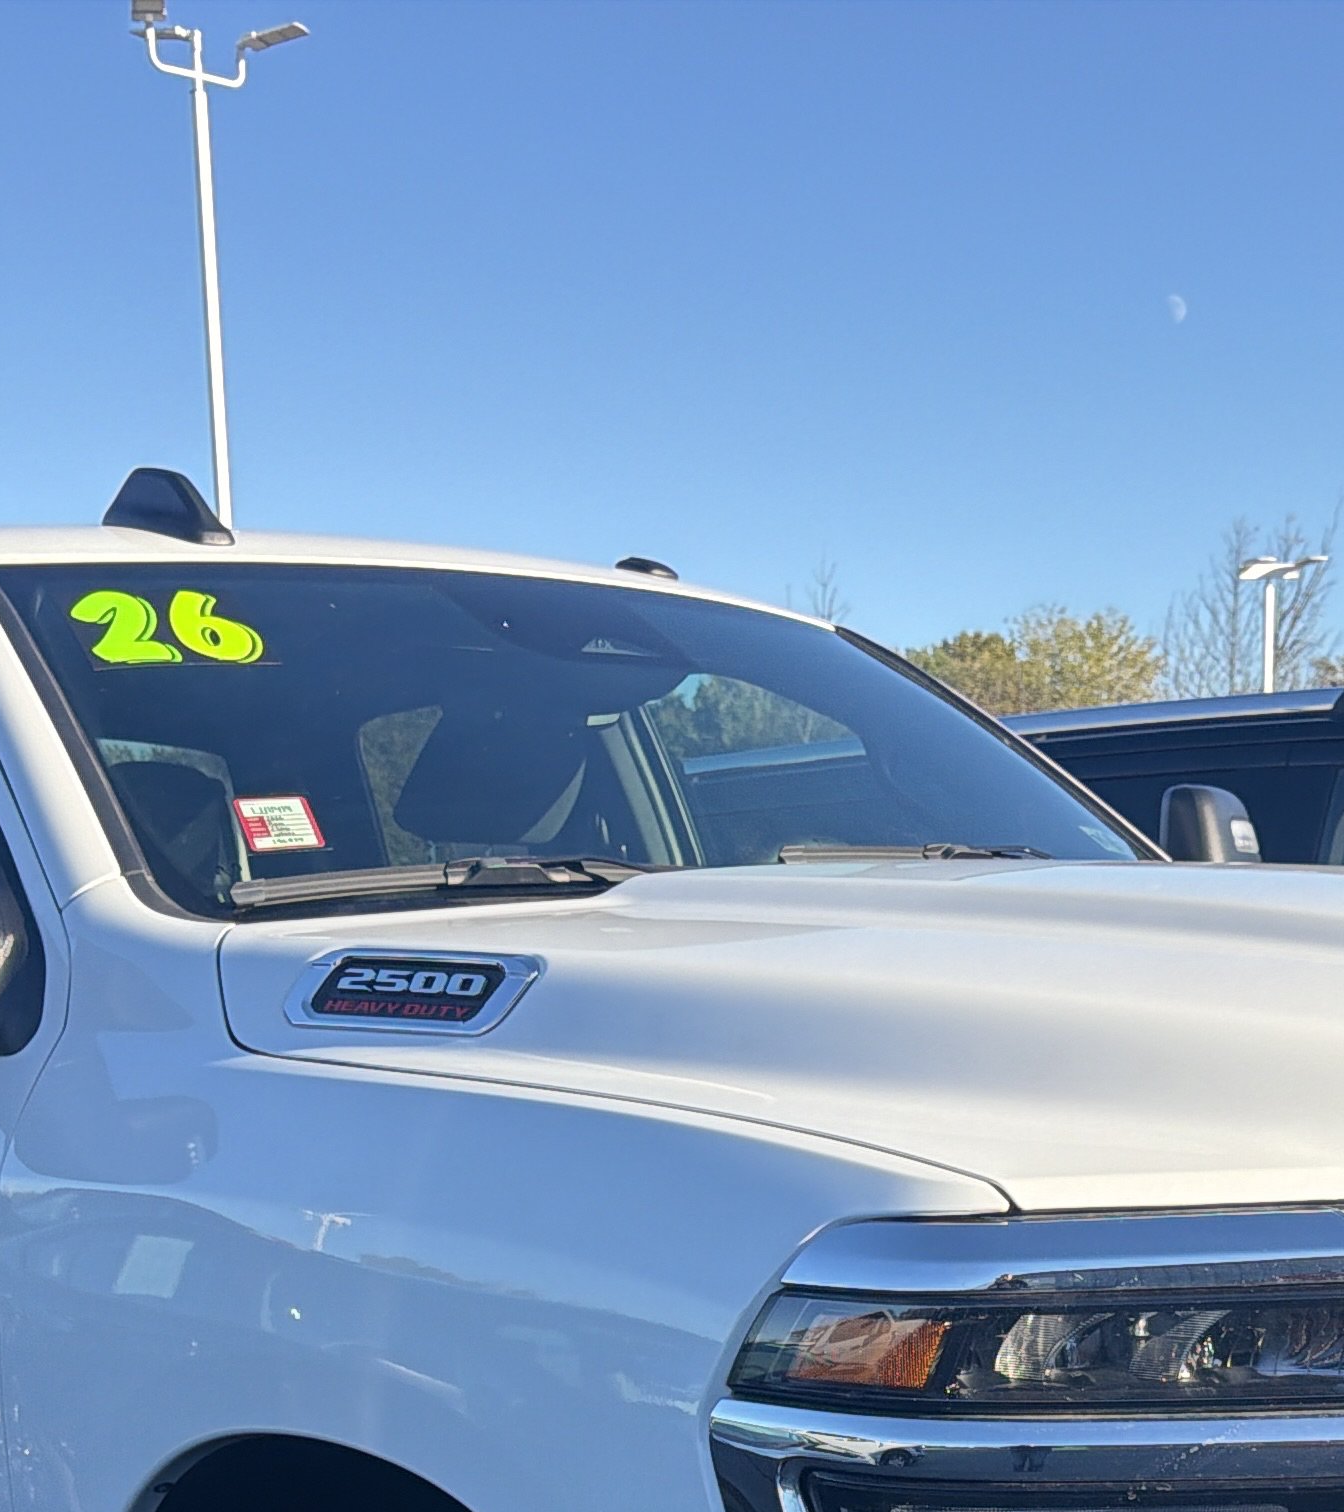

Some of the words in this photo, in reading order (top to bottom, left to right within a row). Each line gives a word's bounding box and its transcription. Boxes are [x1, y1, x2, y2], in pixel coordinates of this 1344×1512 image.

[70, 590, 264, 664] 26
[337, 968, 487, 996] 2500
[323, 999, 398, 1015] HEAVY
[402, 1003, 472, 1019] DUTY
